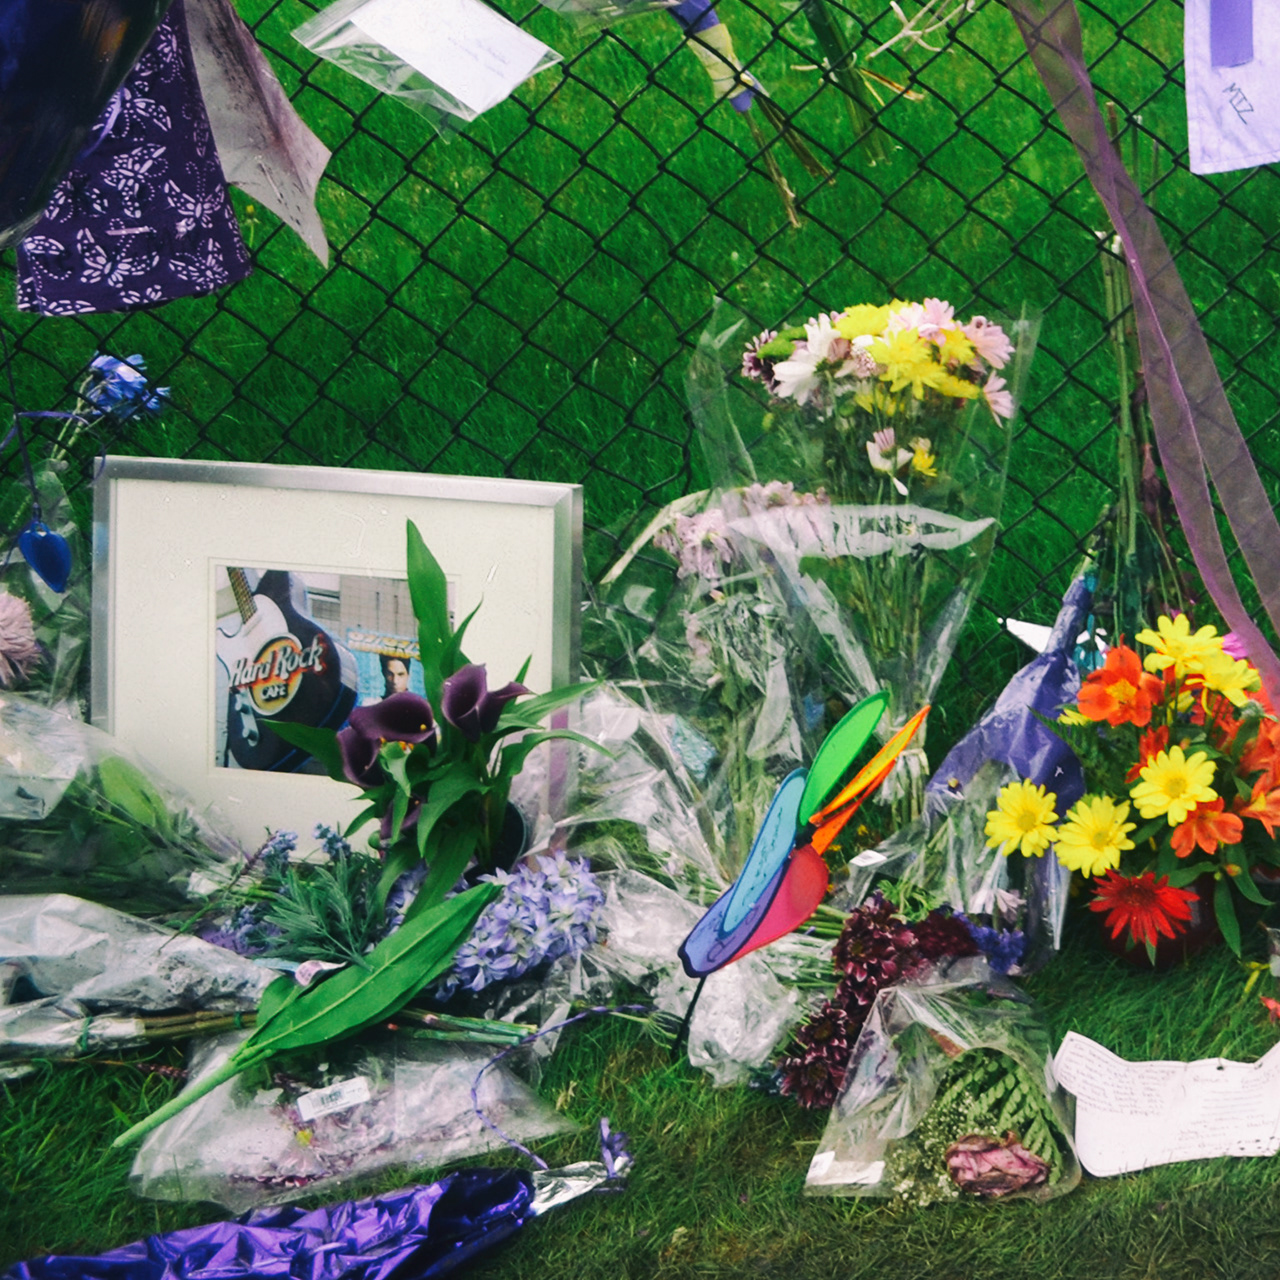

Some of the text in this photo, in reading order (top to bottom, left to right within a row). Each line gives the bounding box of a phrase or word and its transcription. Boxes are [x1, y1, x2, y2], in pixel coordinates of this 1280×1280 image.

[230, 645, 270, 686] Hard
[274, 634, 323, 680] Rock
[261, 684, 287, 701] CAFE
